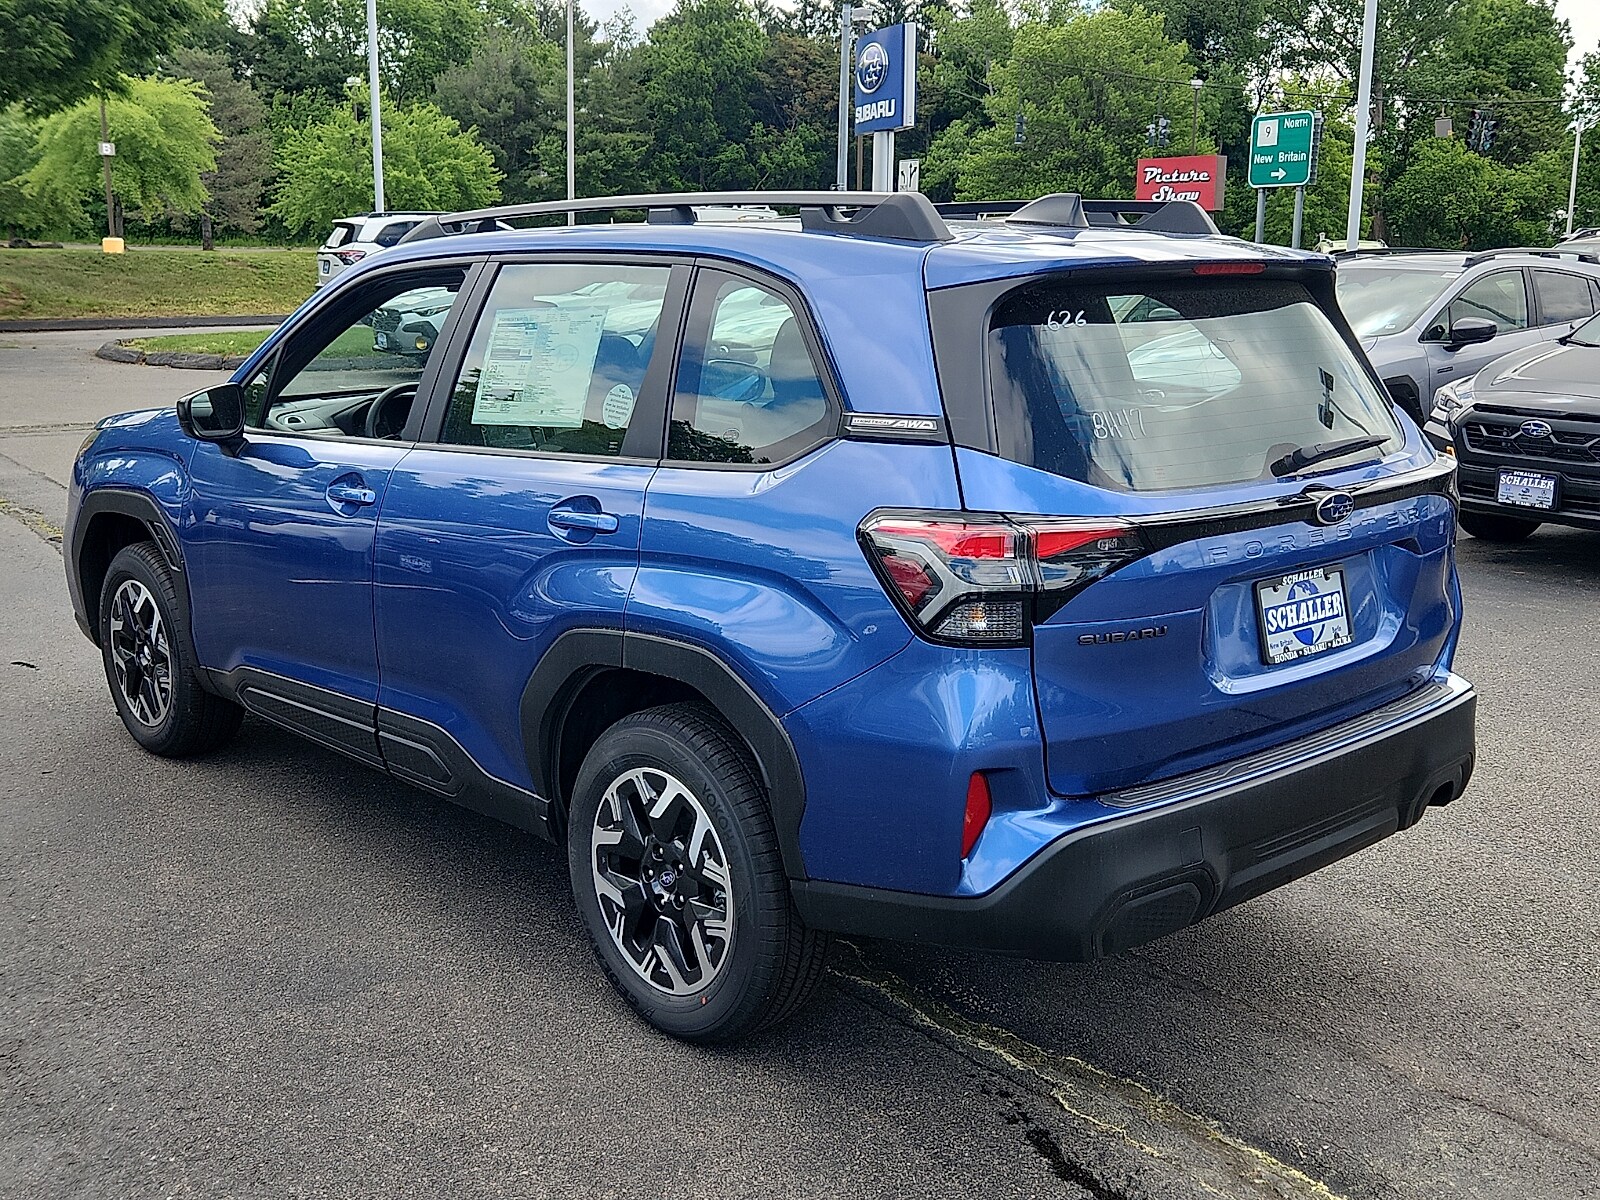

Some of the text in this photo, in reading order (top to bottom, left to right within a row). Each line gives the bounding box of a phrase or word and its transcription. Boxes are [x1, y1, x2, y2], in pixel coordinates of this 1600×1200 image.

[855, 99, 895, 124] SUBARU
[1265, 126, 1272, 138] 9
[1283, 118, 1309, 129] NORTH
[1254, 151, 1307, 164] New Britain
[1143, 167, 1211, 184] Picture
[1151, 185, 1201, 201] Show
[1047, 310, 1087, 331] 626
[889, 420, 936, 430] AWD
[1500, 474, 1555, 491] SCHALLER
[1207, 505, 1421, 565] FORESTER
[1281, 568, 1325, 586] SCHALLER
[1267, 592, 1342, 633] SCHALLER
[1077, 625, 1169, 647] SUBARU
[1274, 634, 1353, 664] HONDA SUBARU ACURA
